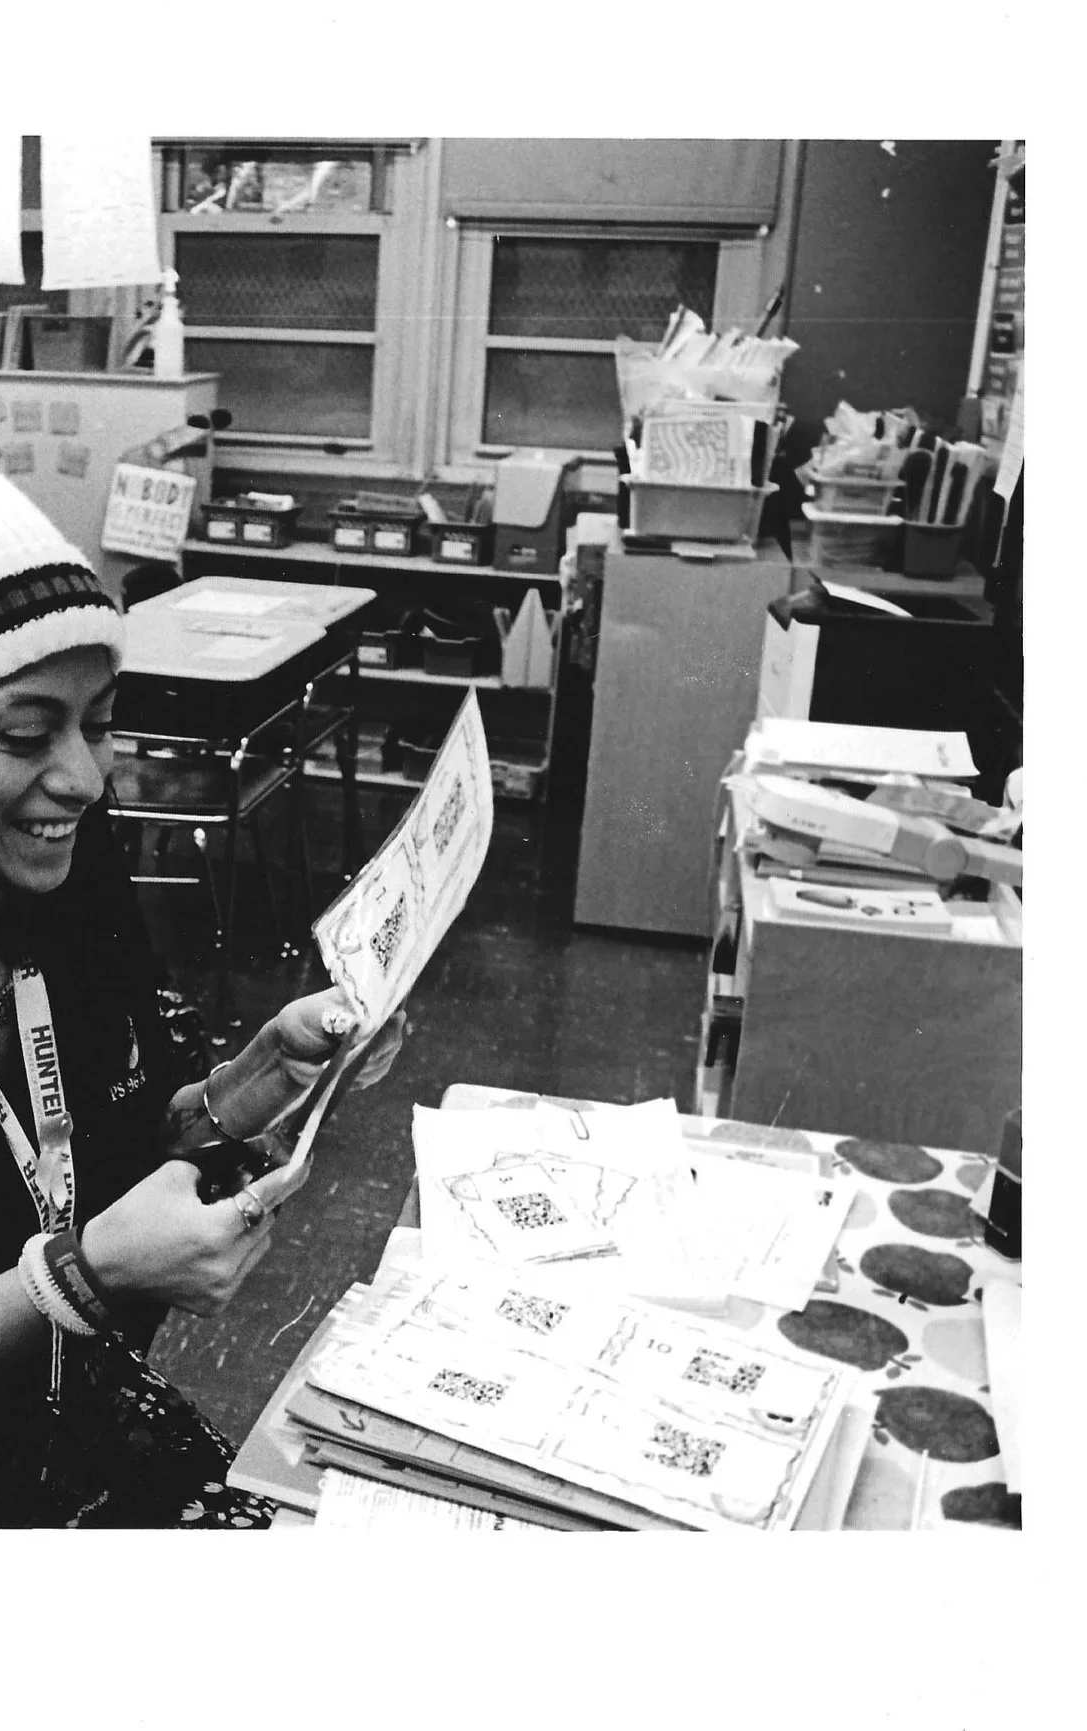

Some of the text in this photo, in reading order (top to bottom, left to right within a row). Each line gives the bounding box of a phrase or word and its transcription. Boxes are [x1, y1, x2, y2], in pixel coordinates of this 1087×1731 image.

[115, 471, 194, 508] NBODY
[30, 1024, 65, 1118] HUNTE
[647, 1338, 672, 1354] 10
